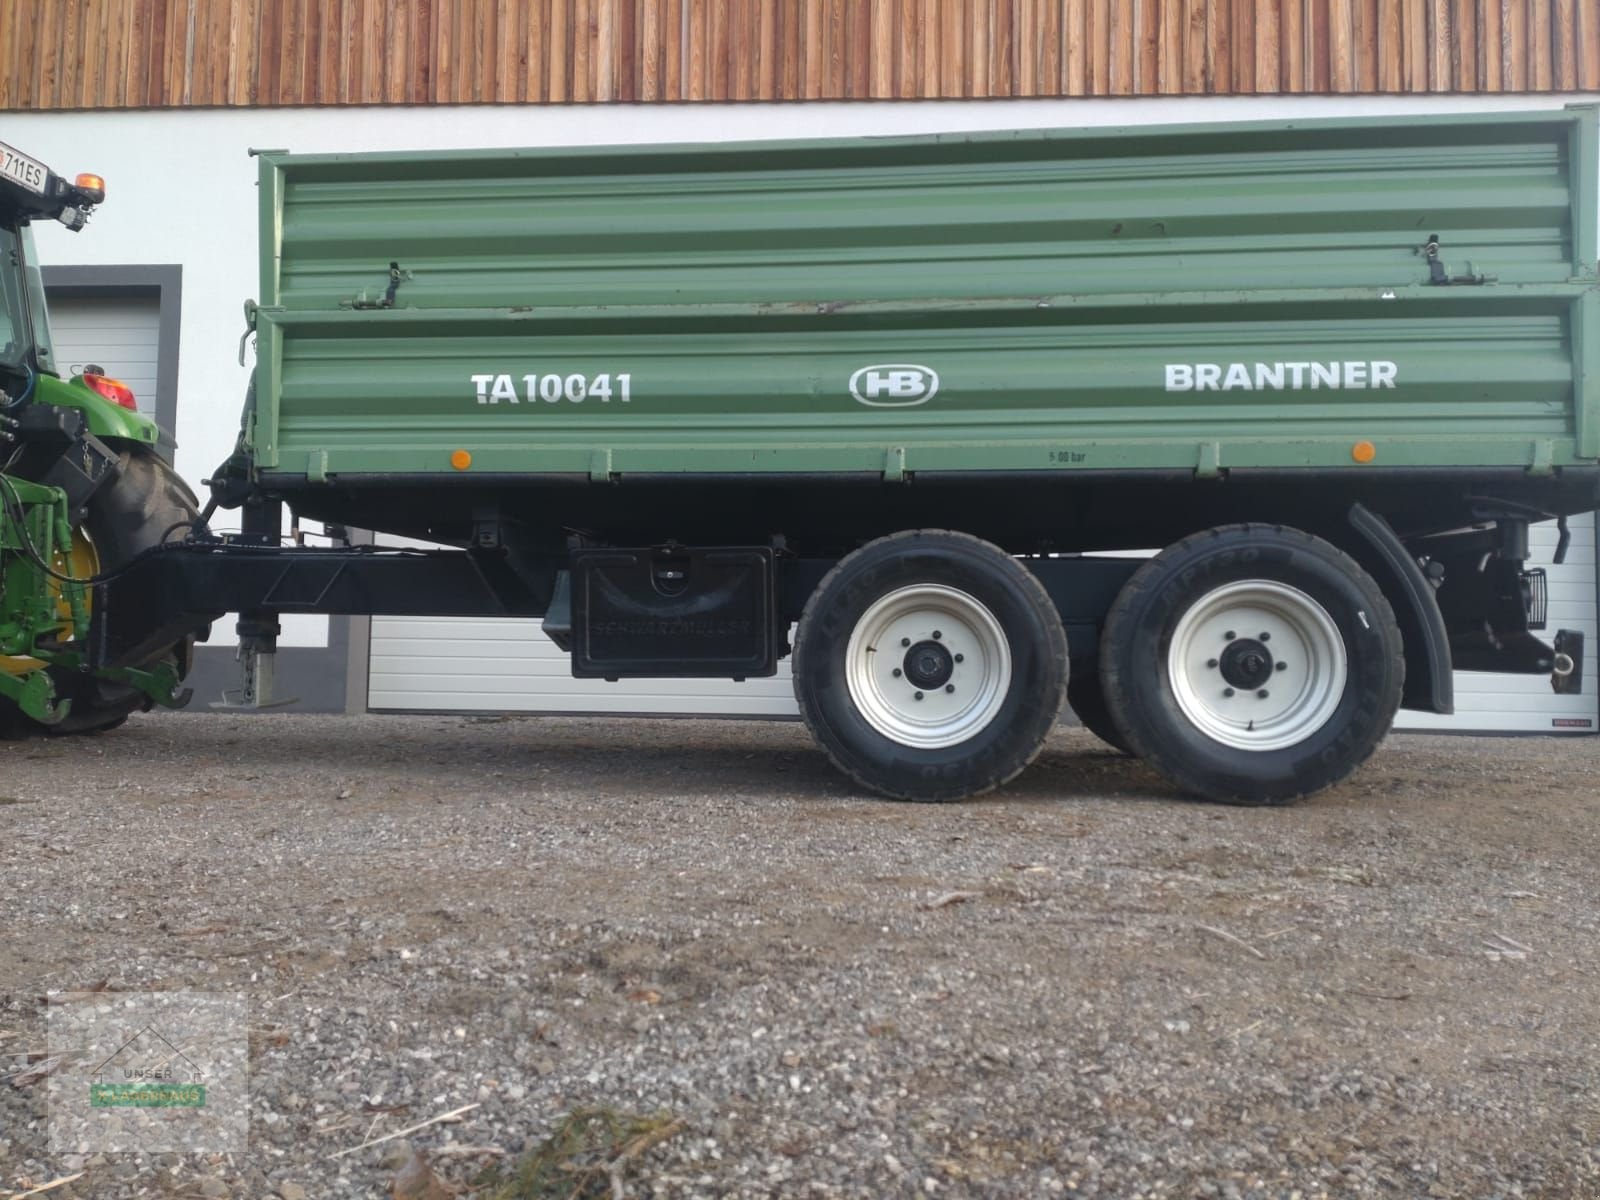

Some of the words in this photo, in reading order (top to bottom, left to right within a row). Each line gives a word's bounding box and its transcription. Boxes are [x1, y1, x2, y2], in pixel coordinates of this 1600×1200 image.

[471, 374, 520, 404] TA
[522, 373, 631, 403] 10041
[866, 371, 926, 397] HB
[1165, 360, 1398, 391] BRANTNER
